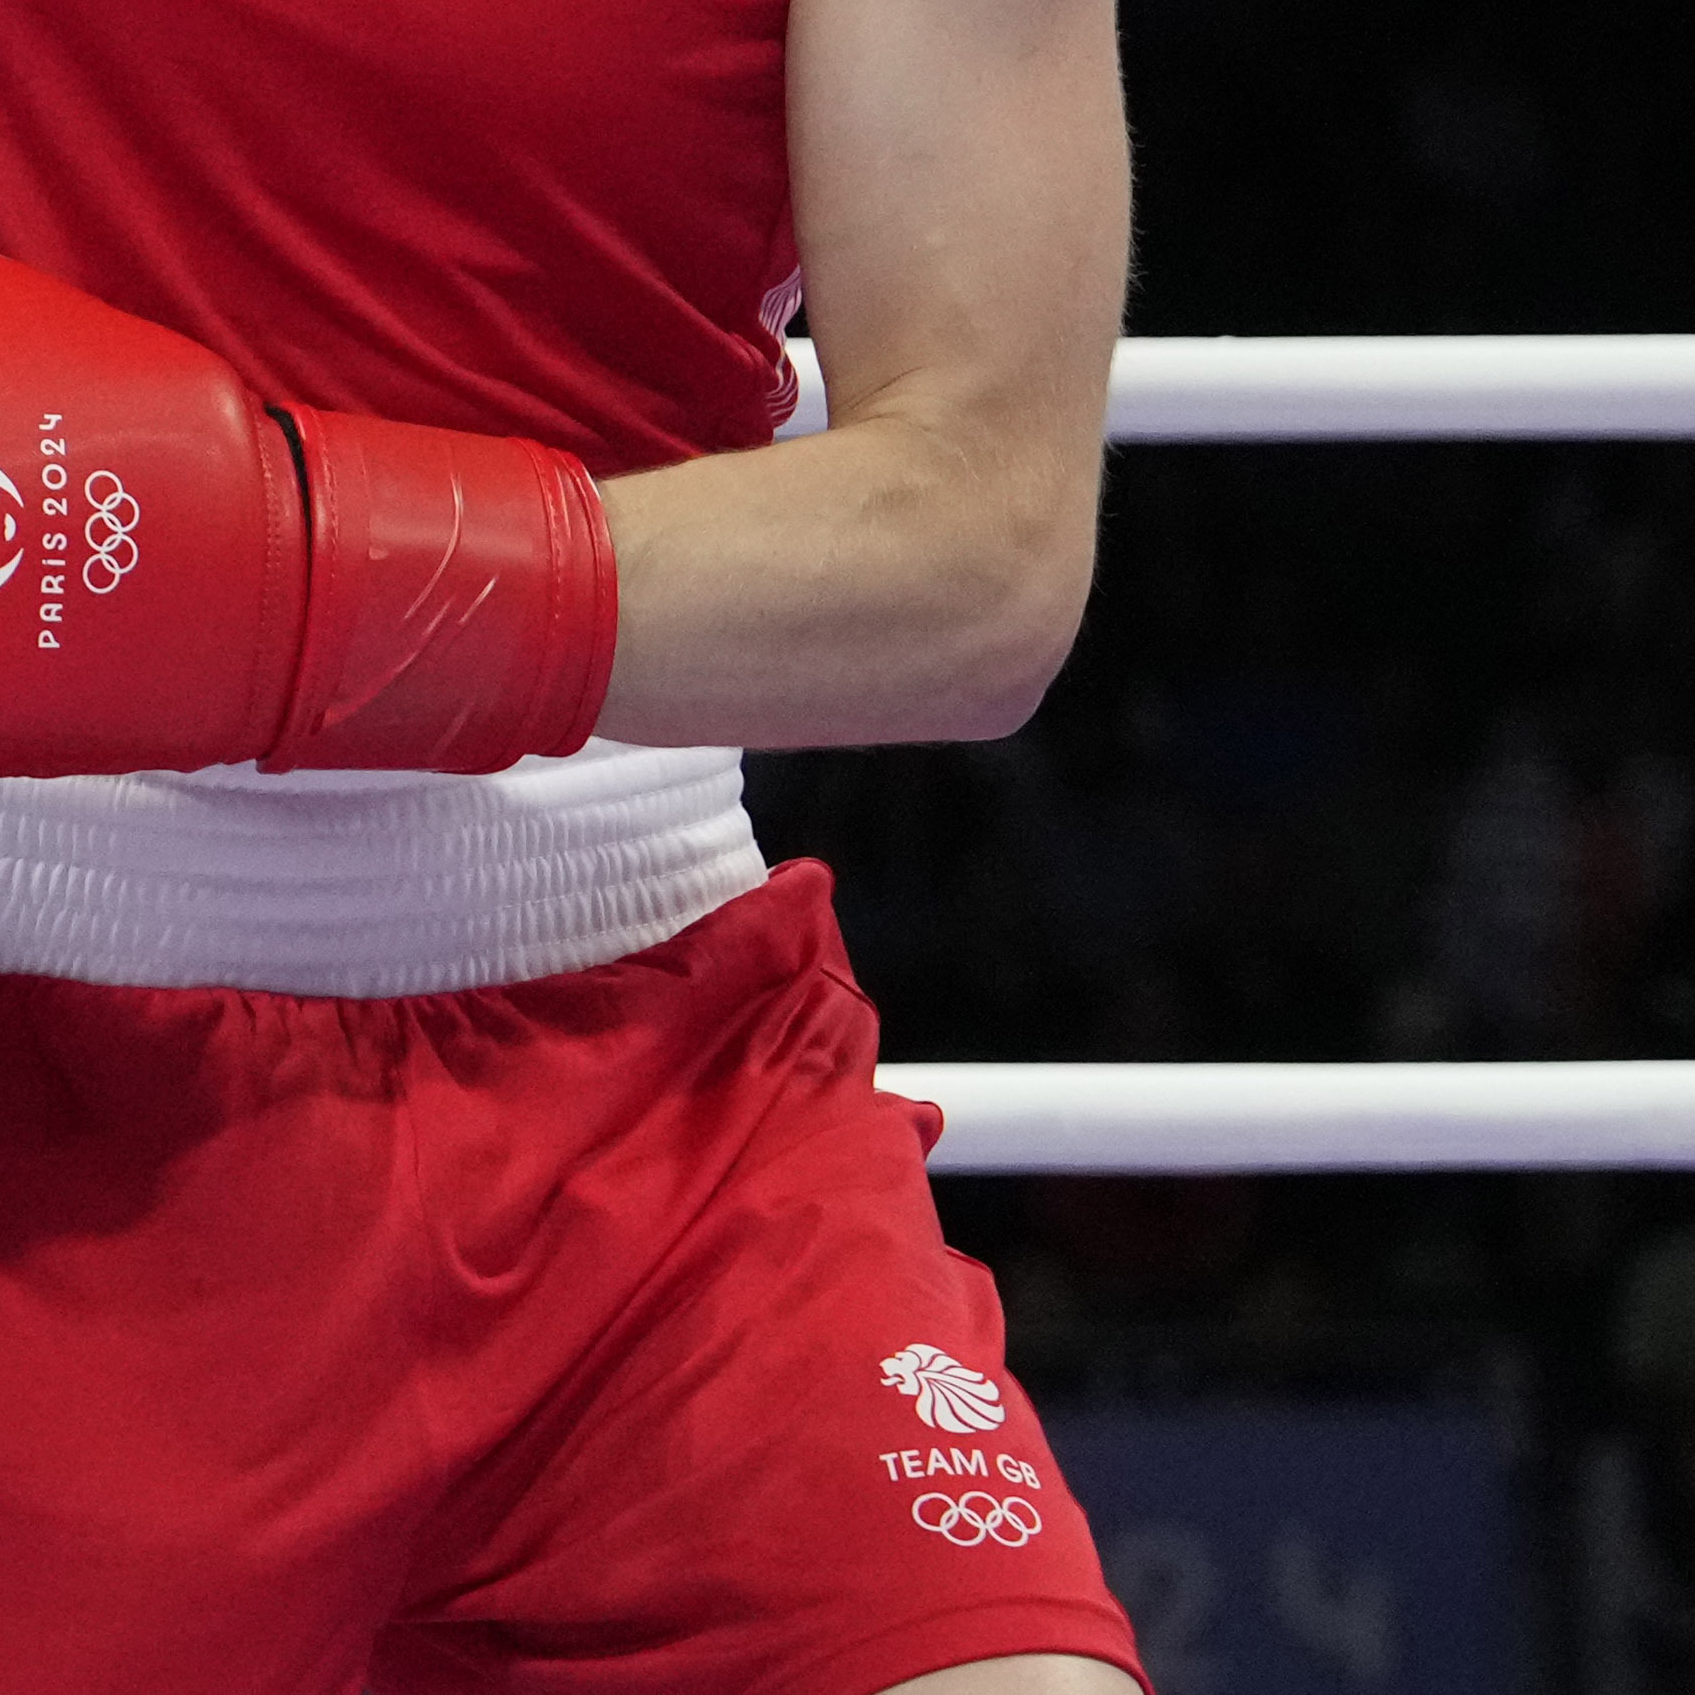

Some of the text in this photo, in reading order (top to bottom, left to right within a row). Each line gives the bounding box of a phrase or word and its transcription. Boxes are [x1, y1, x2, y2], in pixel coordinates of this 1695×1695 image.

[38, 413, 68, 516] 2024
[879, 1448, 1042, 1489] TEAM GB
